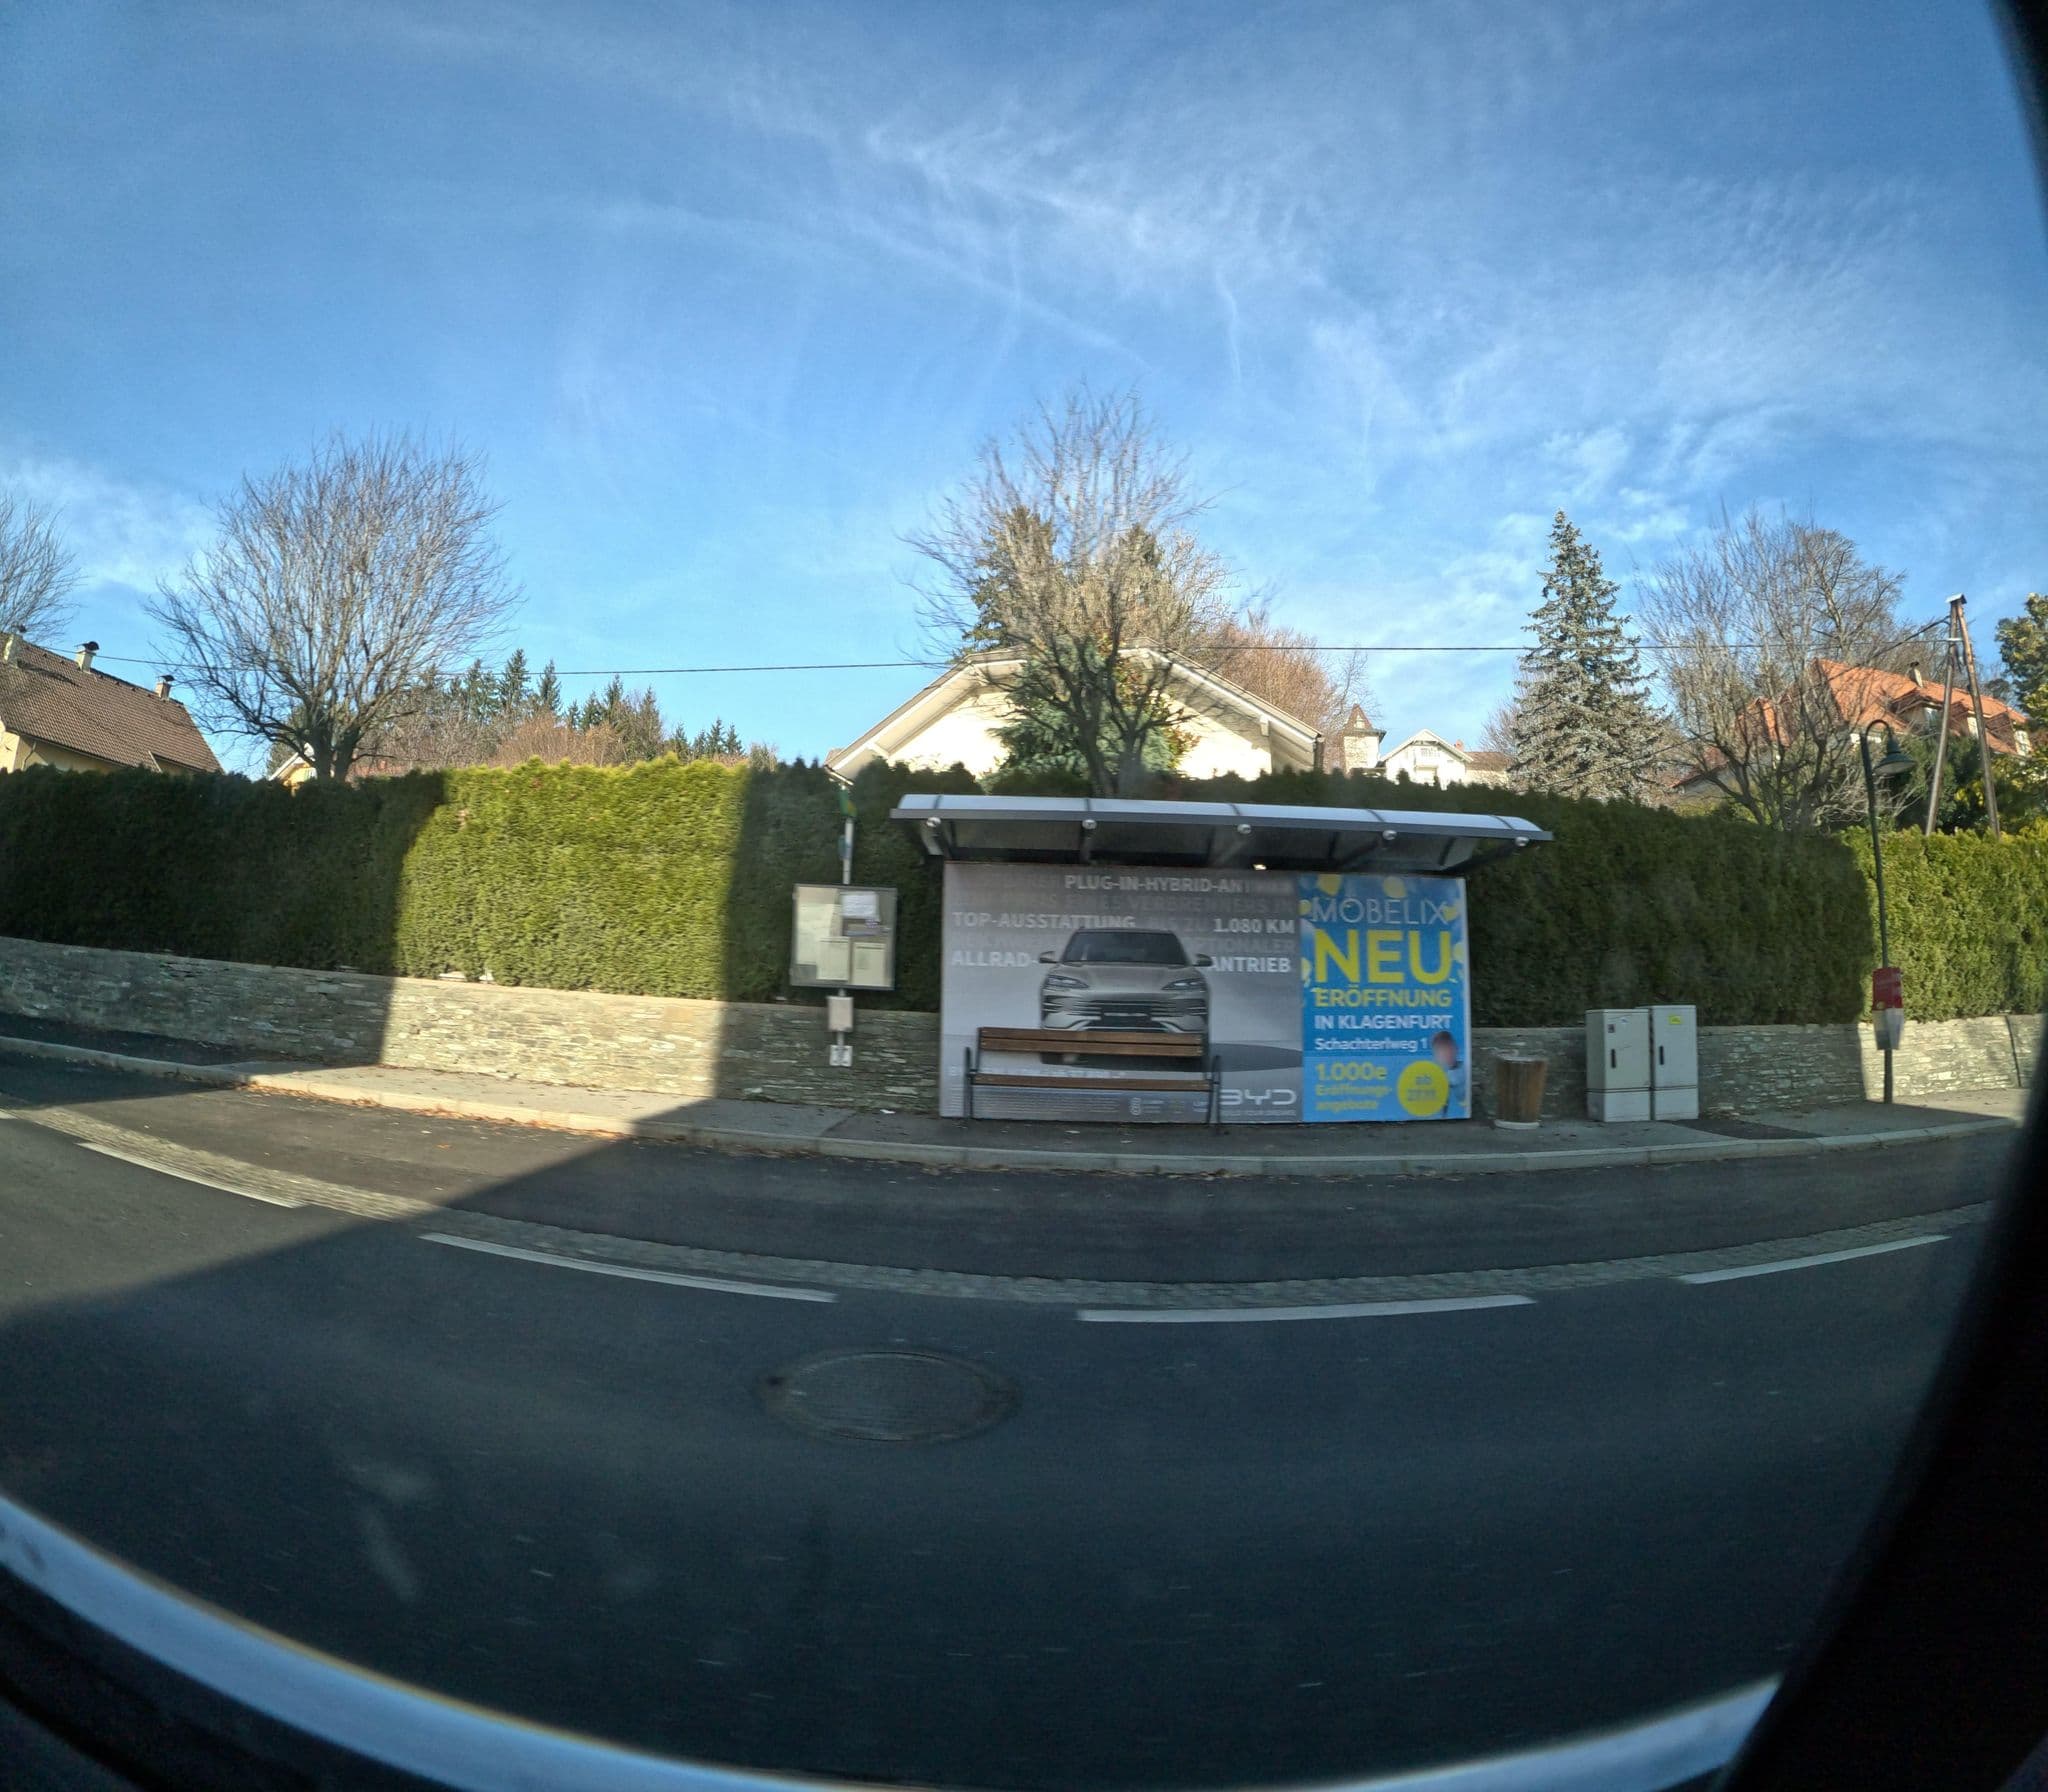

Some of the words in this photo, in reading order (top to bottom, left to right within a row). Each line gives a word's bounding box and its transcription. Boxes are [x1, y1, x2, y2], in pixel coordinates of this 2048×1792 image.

[951, 911, 1136, 929] TOP-AUSSTATTUNG
[1213, 918, 1262, 933] 1.080
[1266, 919, 1295, 934] KM
[951, 949, 1039, 967] ALLRAD-
[1211, 956, 1291, 974] ANTRIEB
[1314, 929, 1452, 985] NEU
[1315, 984, 1452, 1007] ERÖFFNUNG
[1314, 1014, 1334, 1029] IN
[1338, 1014, 1453, 1030] KLAGENFURT
[1315, 1037, 1418, 1052] Schachterlweg
[1420, 1037, 1428, 1049] 1
[1220, 1089, 1297, 1106] BYD
